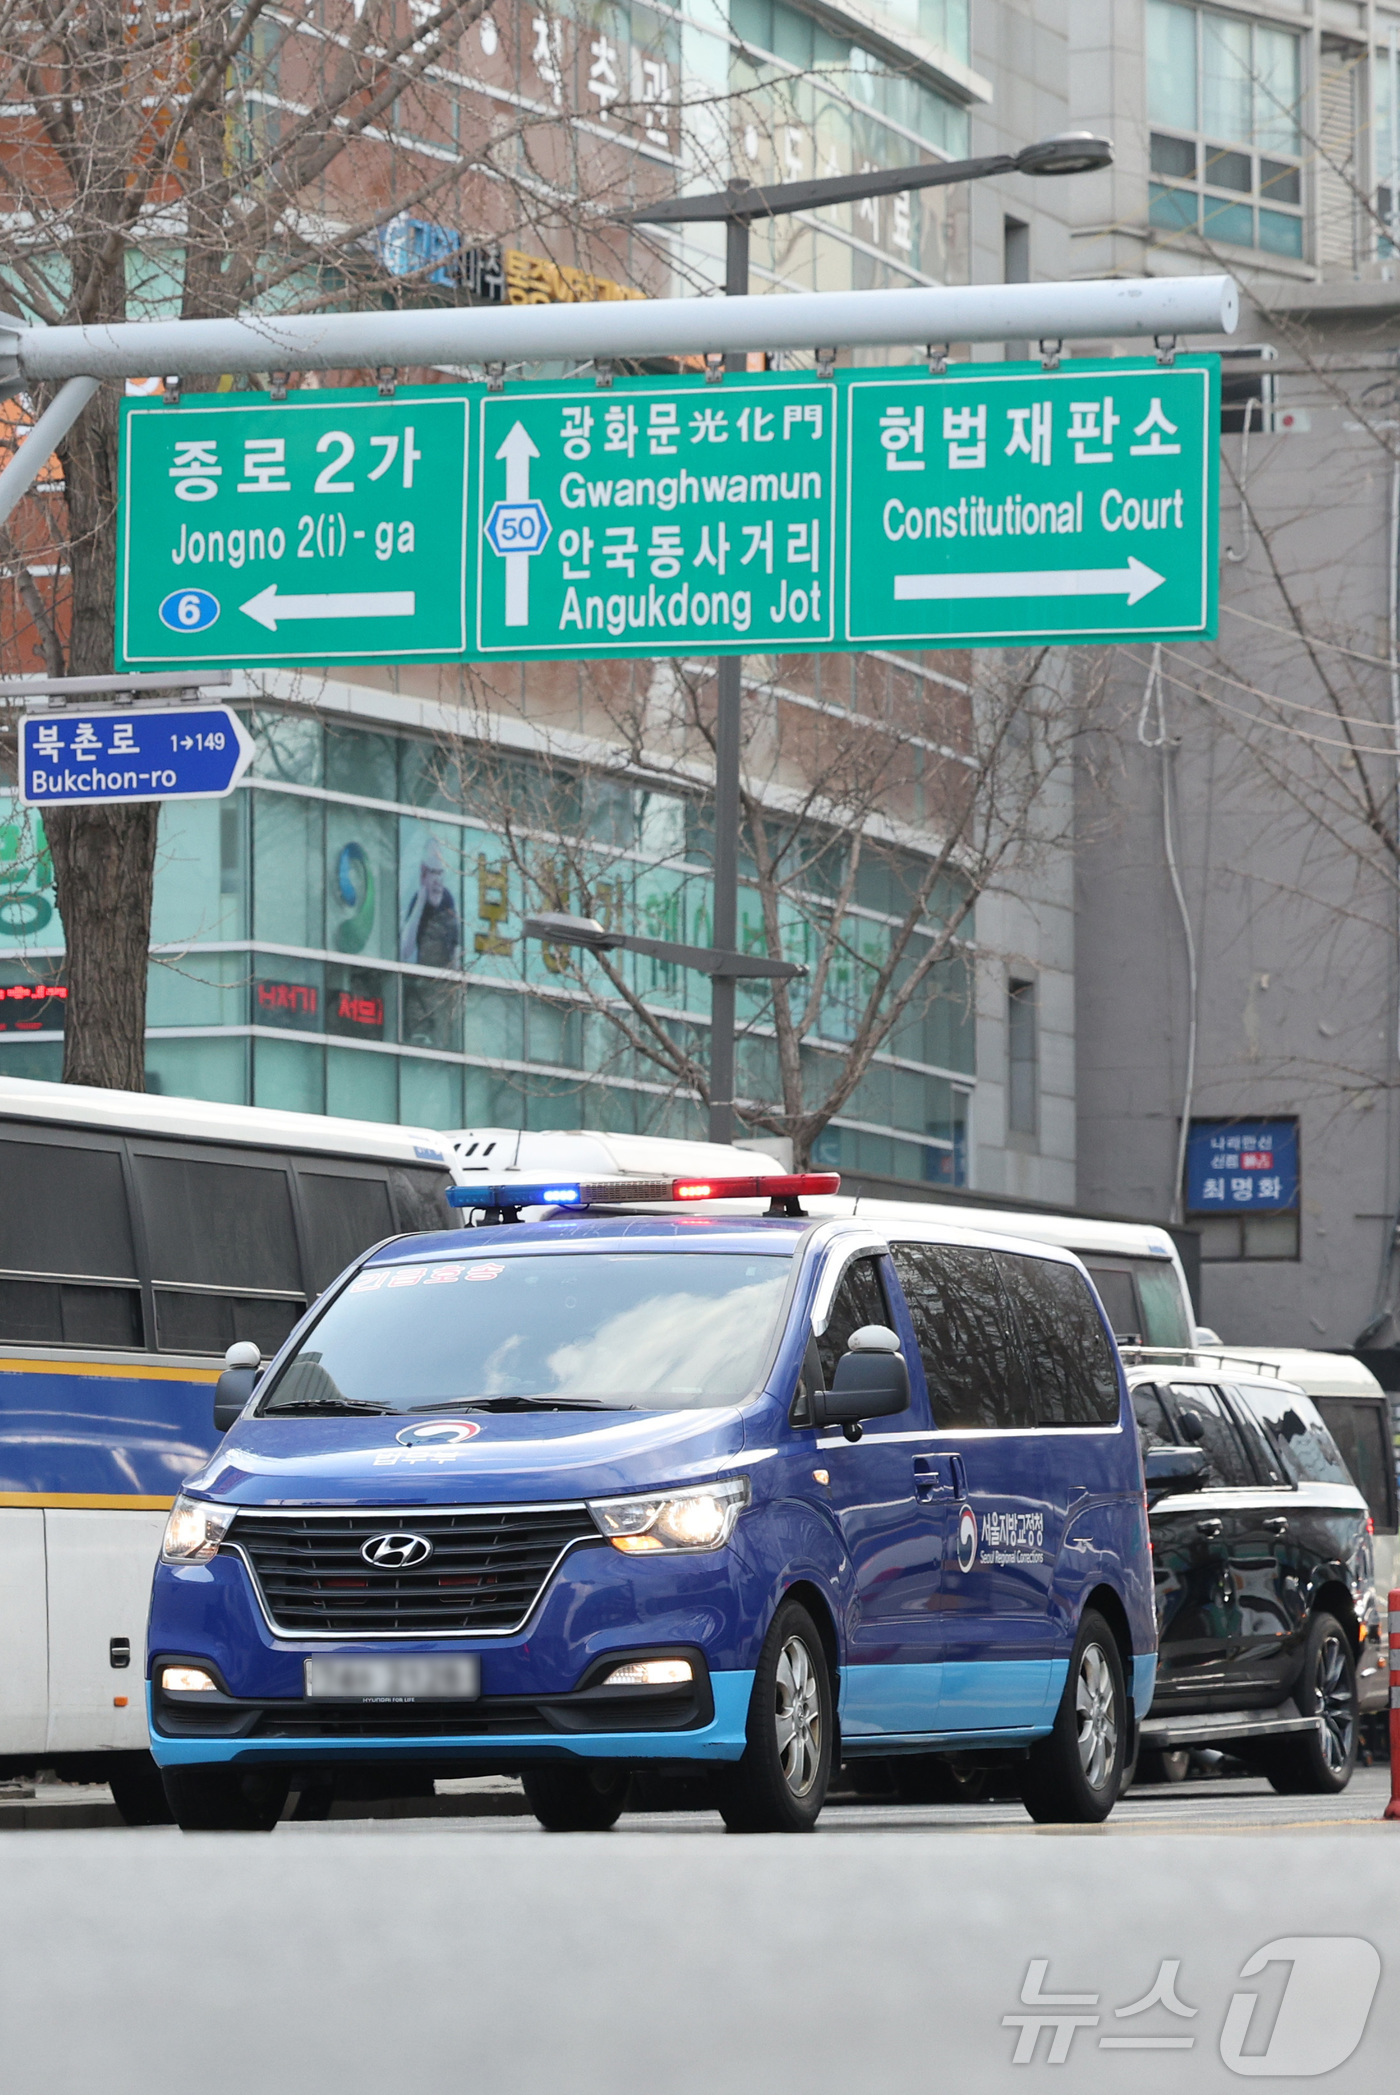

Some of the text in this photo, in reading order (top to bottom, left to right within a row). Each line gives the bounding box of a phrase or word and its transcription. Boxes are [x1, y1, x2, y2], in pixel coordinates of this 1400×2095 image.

[879, 396, 1181, 472] 헌법재판소
[168, 426, 421, 502] 종로 2가
[560, 468, 822, 511] Gwanghwamun
[501, 516, 535, 541] 50
[882, 488, 1184, 542] Constitutional Court
[171, 523, 286, 569] Jongno
[558, 519, 820, 580] 안국동사거리
[177, 594, 201, 626] 6
[559, 579, 822, 636] Angukdong Jot
[32, 722, 140, 763] 북촌로
[32, 767, 177, 793] Bukchon-ro
[1203, 1175, 1283, 1201] 최명화
[350, 1263, 506, 1293] 긴급호송
[981, 1511, 1044, 1547] 서울지방교정청
[980, 1549, 1044, 1567] Seoul Regional Corrections
